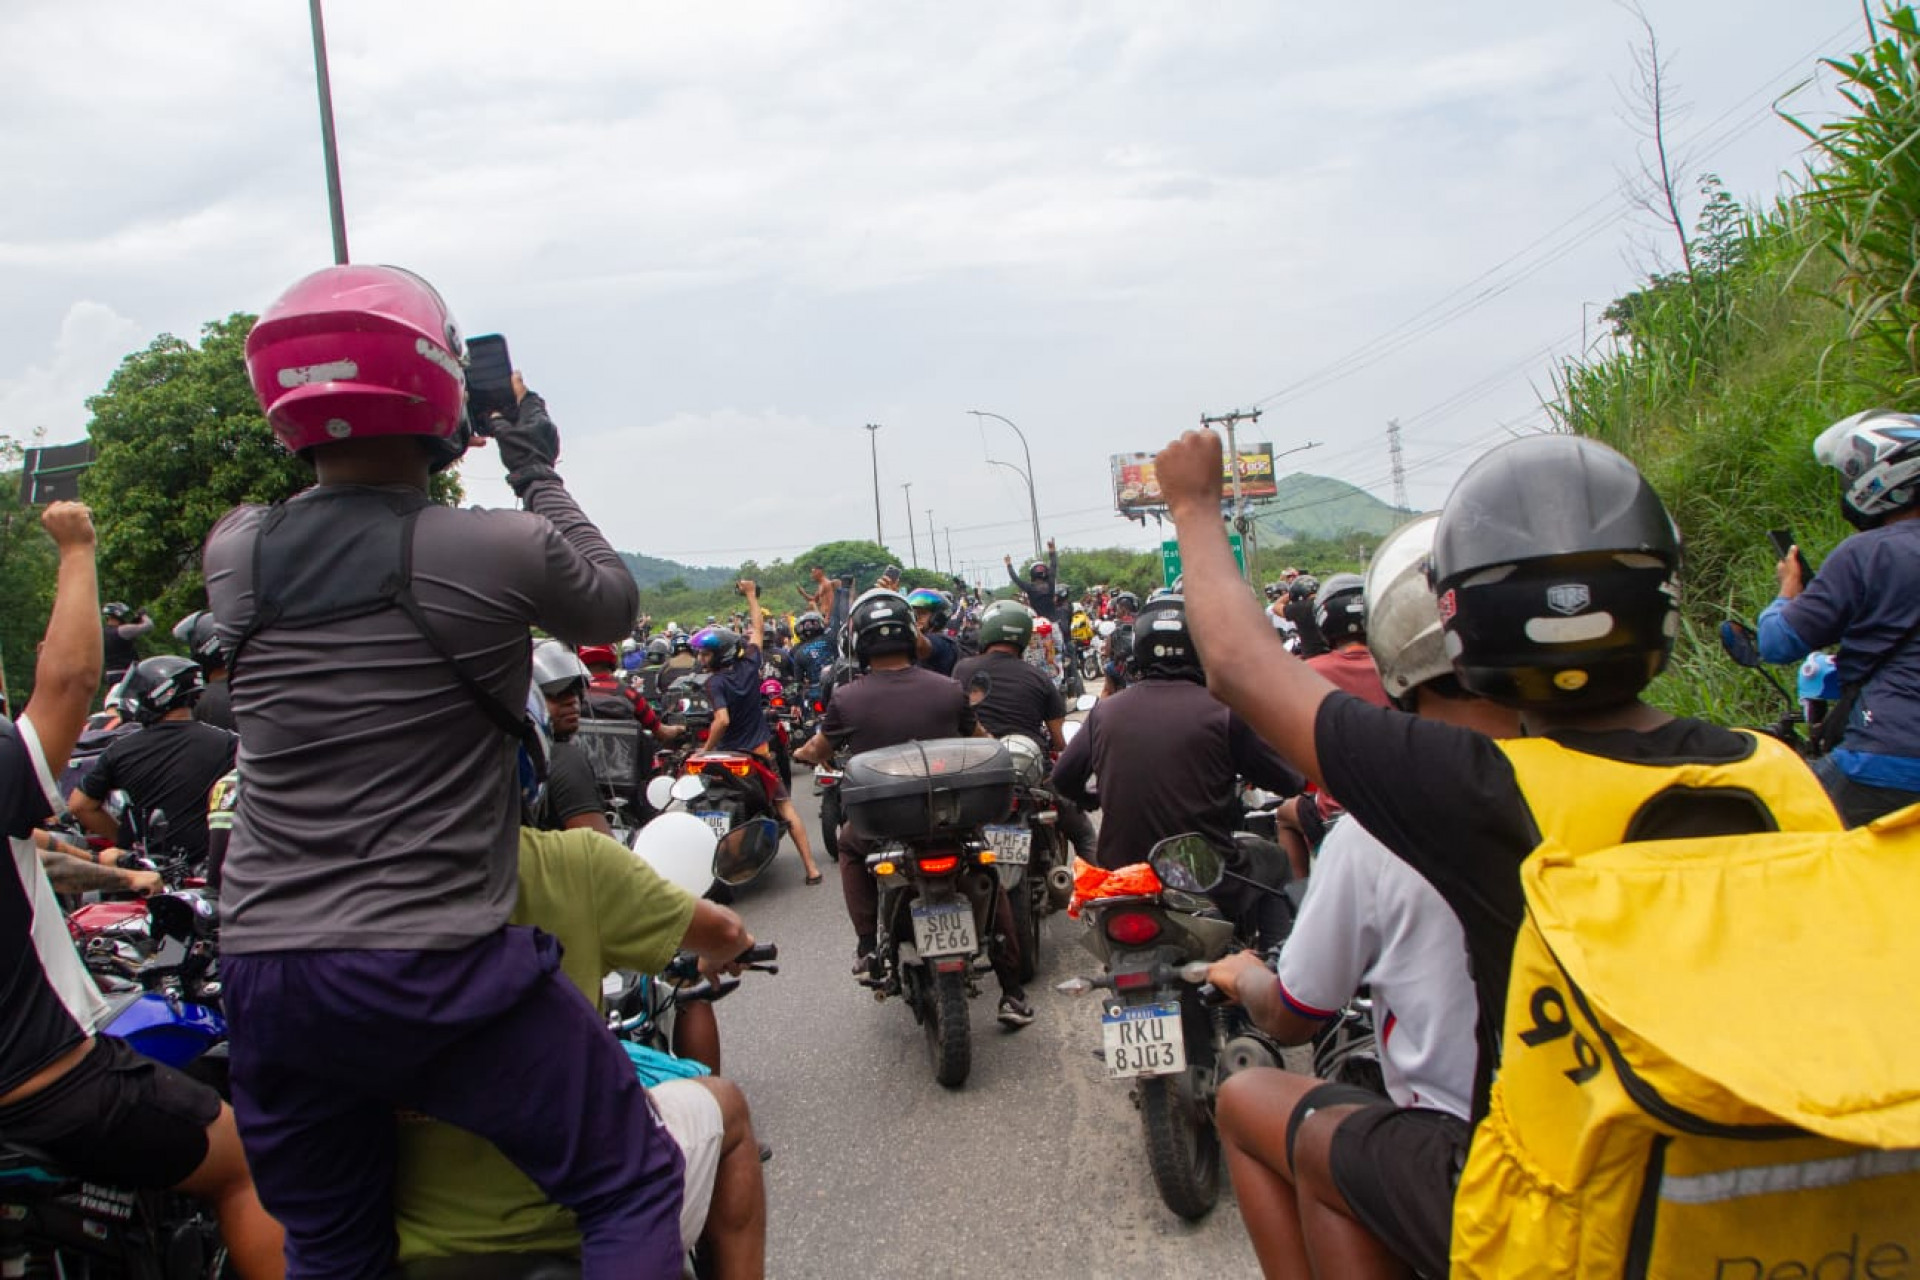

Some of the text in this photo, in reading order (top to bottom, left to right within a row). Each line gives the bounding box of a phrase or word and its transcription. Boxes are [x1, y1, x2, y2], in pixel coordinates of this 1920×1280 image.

[927, 911, 962, 932] SRU
[923, 928, 970, 951] 7E66
[1120, 1018, 1164, 1044] RKU
[1115, 1042, 1175, 1072] 8J03
